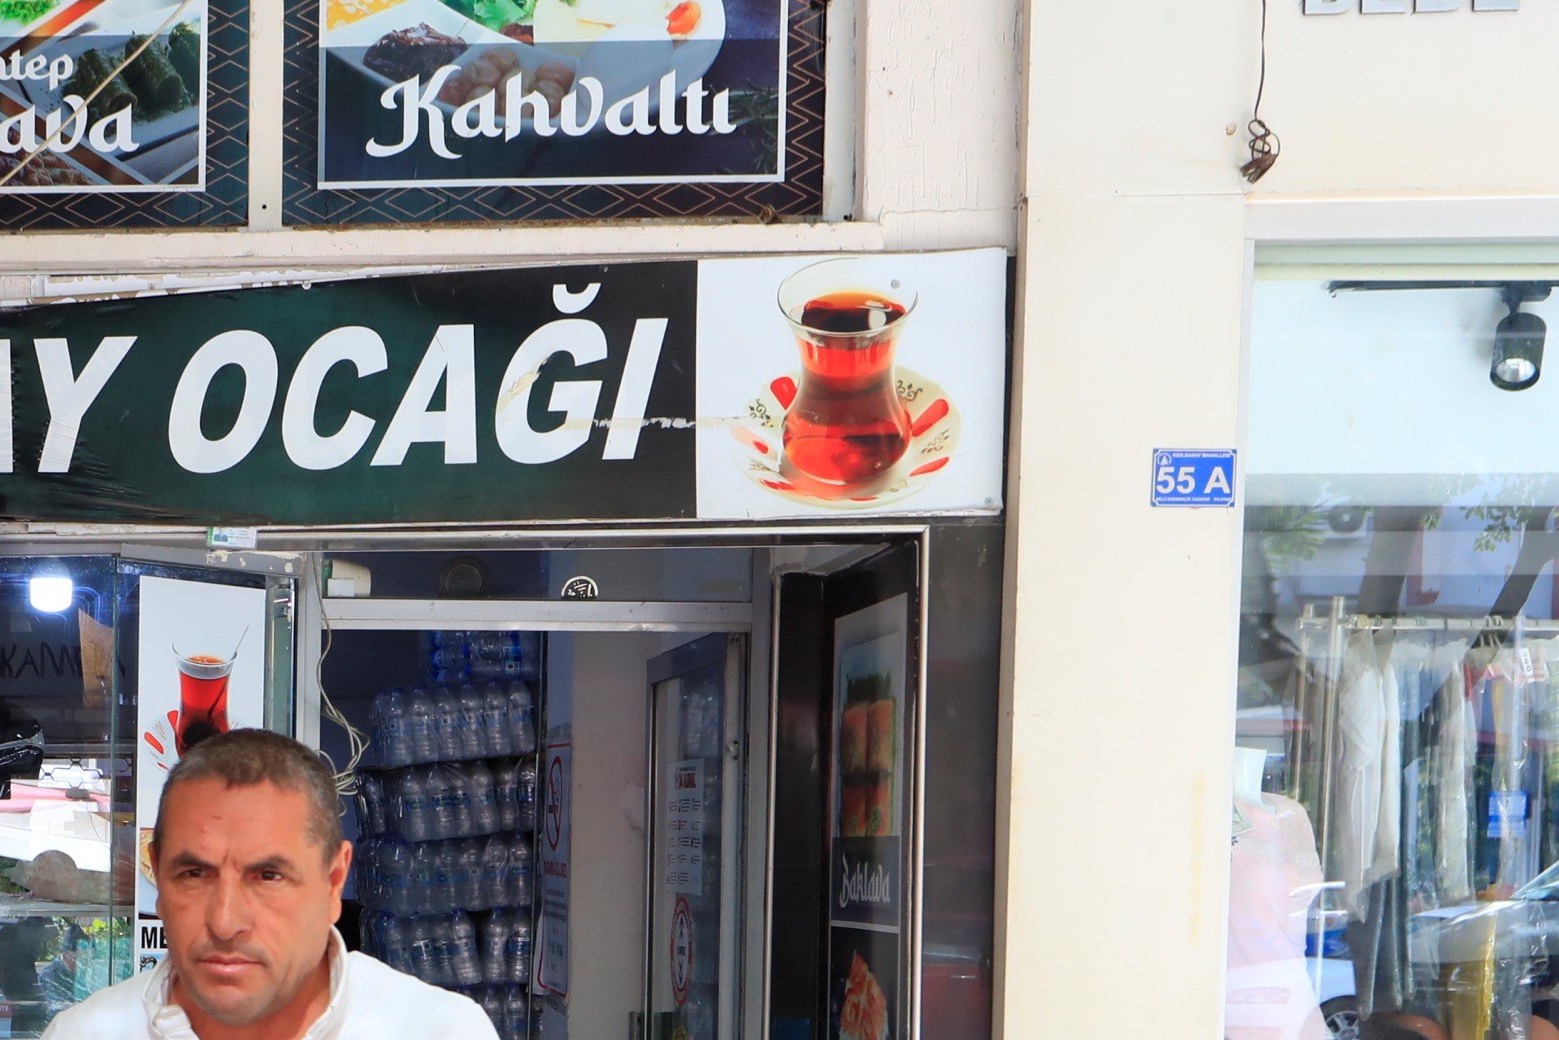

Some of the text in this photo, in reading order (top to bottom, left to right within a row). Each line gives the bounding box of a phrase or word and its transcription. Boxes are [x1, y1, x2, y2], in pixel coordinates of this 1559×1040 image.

[365, 64, 738, 159] Kahvaltı
[169, 283, 669, 474] OCAĞI
[1156, 466, 1231, 494] 55 A
[840, 853, 891, 908] Baklava
